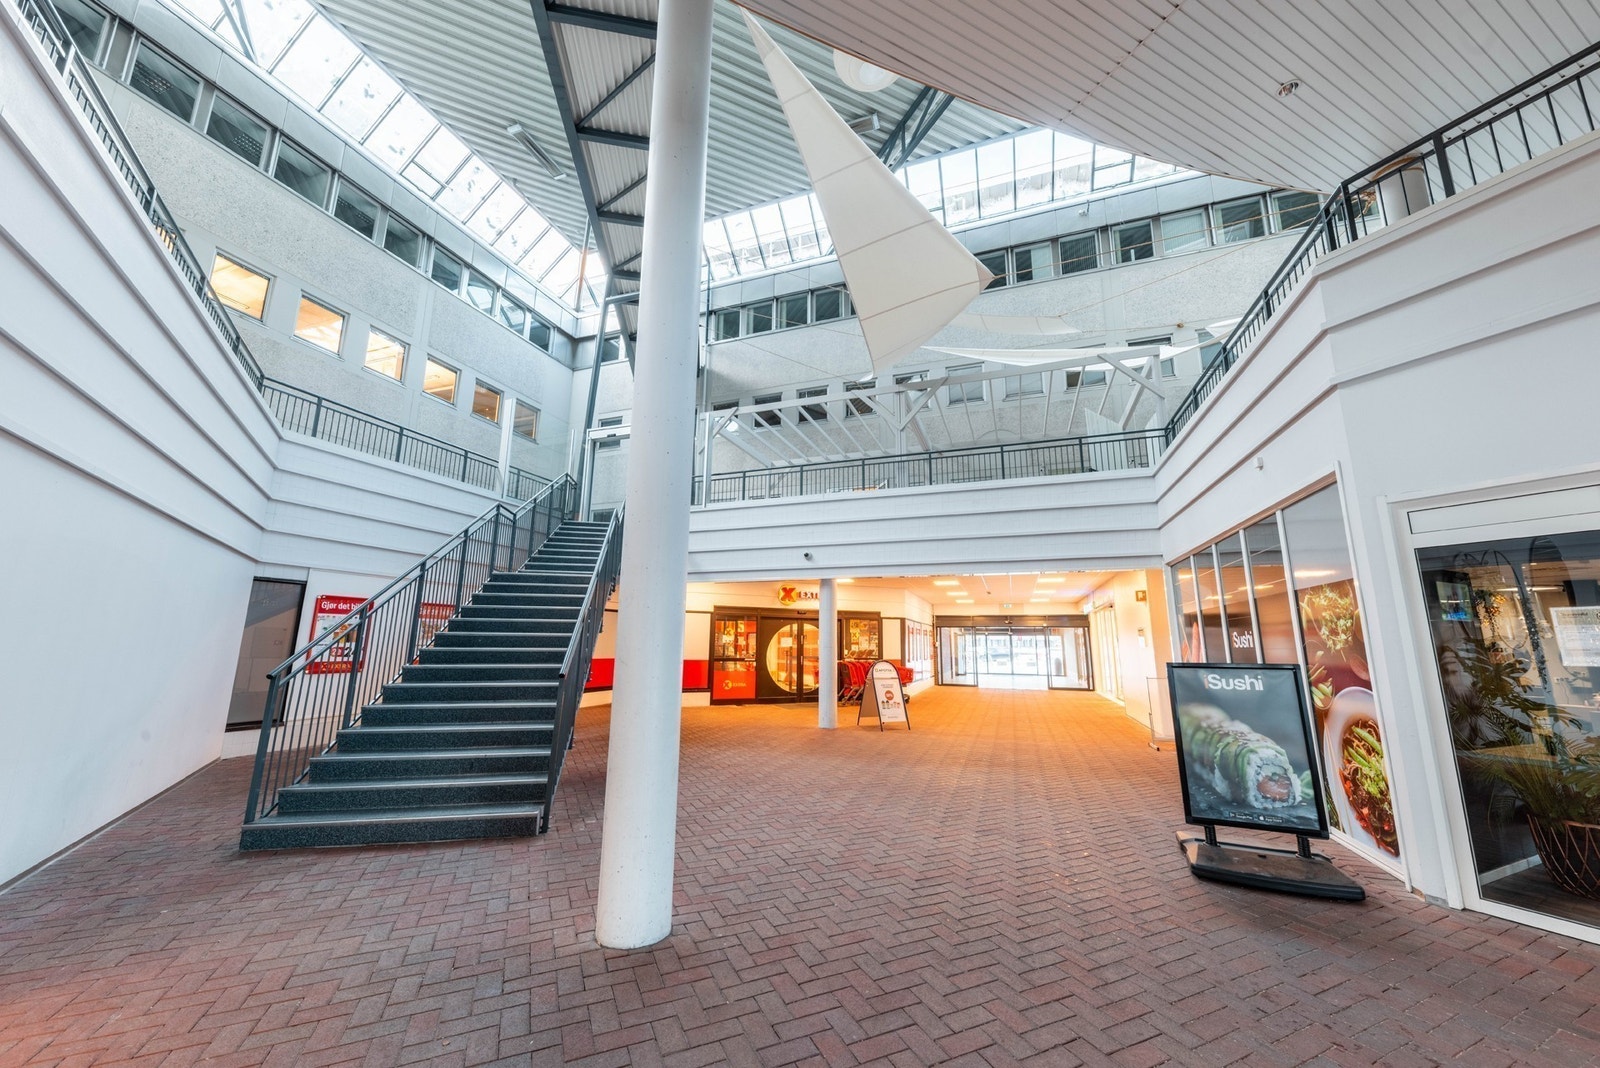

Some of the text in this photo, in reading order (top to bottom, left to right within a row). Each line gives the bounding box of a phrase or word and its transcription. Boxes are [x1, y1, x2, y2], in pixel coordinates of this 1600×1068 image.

[321, 601, 337, 610] Gjør
[338, 602, 350, 610] det
[1203, 674, 1264, 691] iSushi
